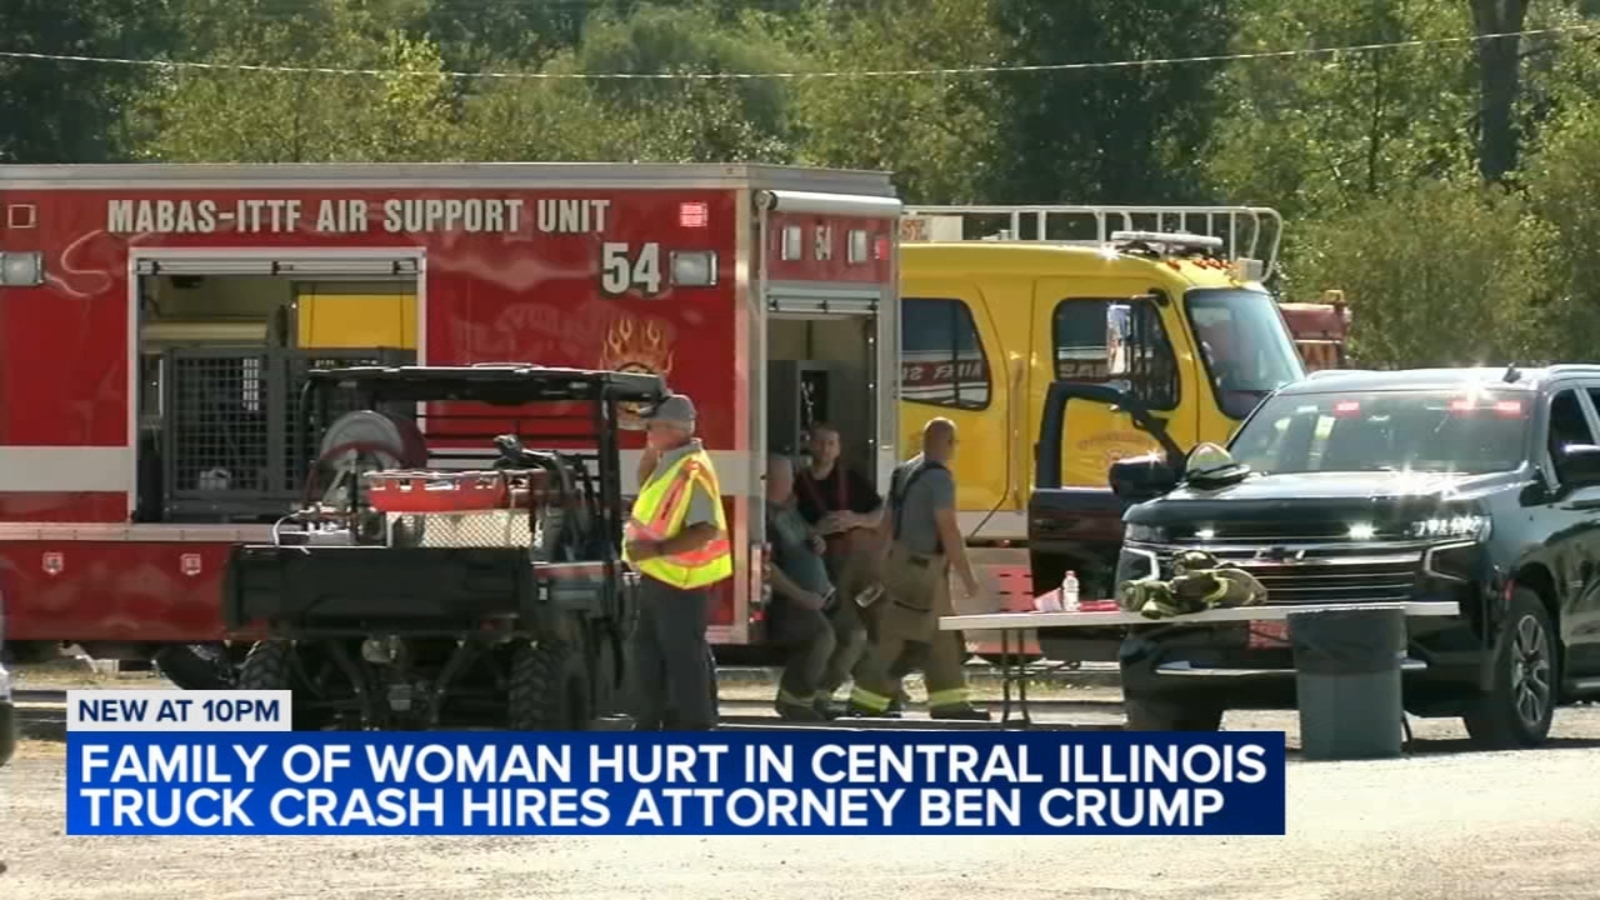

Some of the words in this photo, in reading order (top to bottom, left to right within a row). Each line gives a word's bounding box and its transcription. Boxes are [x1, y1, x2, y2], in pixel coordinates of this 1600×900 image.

[107, 198, 302, 234] MABAS-ITTF
[315, 199, 369, 232] AIR
[383, 198, 524, 233] SUPPORT
[537, 198, 611, 233] UNIT
[601, 241, 662, 295] 54
